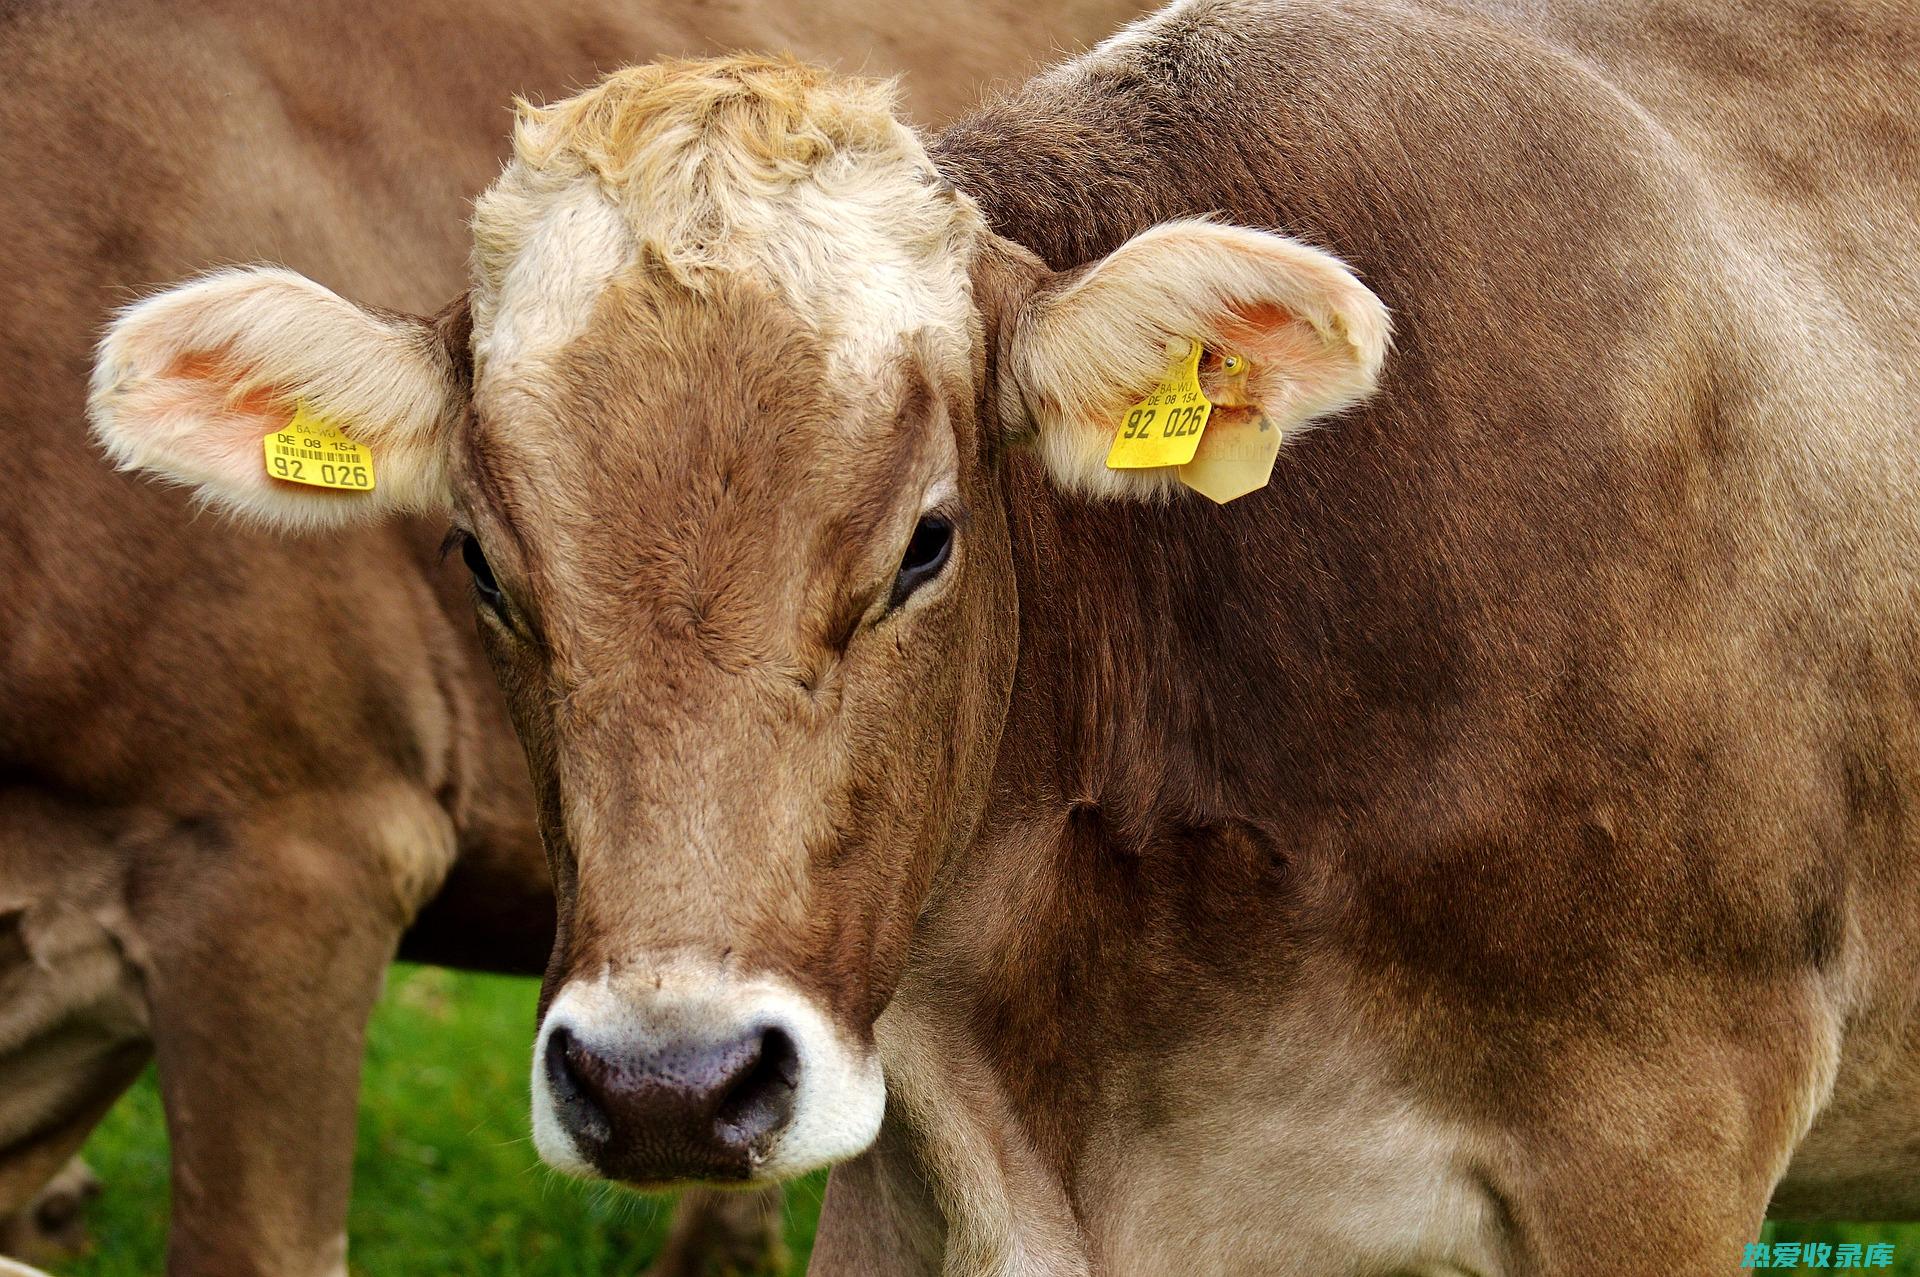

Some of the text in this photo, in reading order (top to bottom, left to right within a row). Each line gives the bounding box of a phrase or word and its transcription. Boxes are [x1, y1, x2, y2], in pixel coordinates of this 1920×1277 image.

[1148, 393, 1198, 406] DE 08 154
[1124, 405, 1204, 439] 92 026
[278, 434, 356, 451] DE 08 154
[274, 457, 368, 487] 92 026
